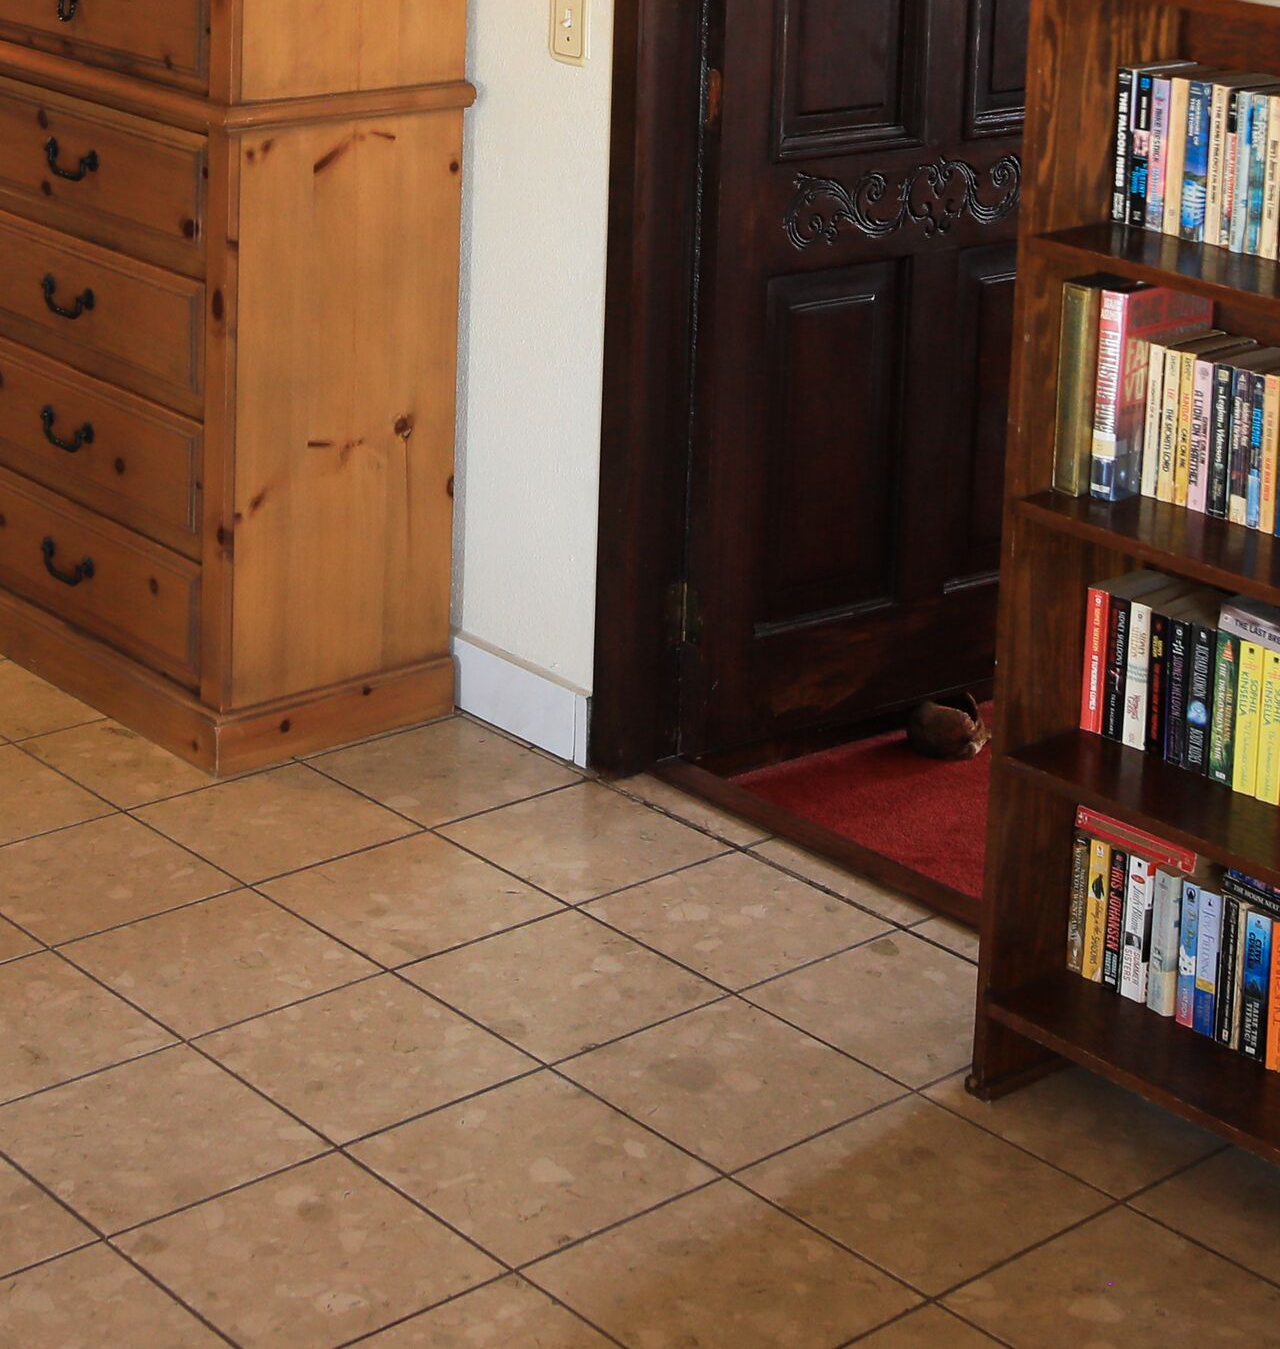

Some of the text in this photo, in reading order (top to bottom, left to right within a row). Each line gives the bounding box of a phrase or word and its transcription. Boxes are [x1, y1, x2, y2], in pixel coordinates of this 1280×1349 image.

[1118, 92, 1128, 112] THE
[1117, 114, 1127, 155] FALCON
[1115, 157, 1125, 187] RISES
[1192, 398, 1203, 420] LION
[1215, 395, 1226, 463] Legion Videssos
[1162, 409, 1173, 472] THE STORM LORD
[1191, 423, 1201, 436] ON
[1235, 619, 1248, 631] THE
[1248, 624, 1267, 638] LAST
[1172, 655, 1183, 716] SIDNEY SHELDON
[1218, 663, 1226, 679] THE
[1190, 643, 1209, 745] RICHARD BODY
[1239, 671, 1250, 716] KINSELLA
[1249, 680, 1258, 714] SOPHIE
[1263, 681, 1274, 726] KINSELLA
[1073, 872, 1081, 893] YOU
[1106, 866, 1124, 950] IRIS JOHANSEN
[1131, 885, 1144, 934] Judy Blume
[1123, 948, 1132, 982] SISTERS
[1132, 952, 1140, 985] SUMMER
[1200, 934, 1214, 978] FIELDING
[1244, 1002, 1252, 1042] TITANIC!
